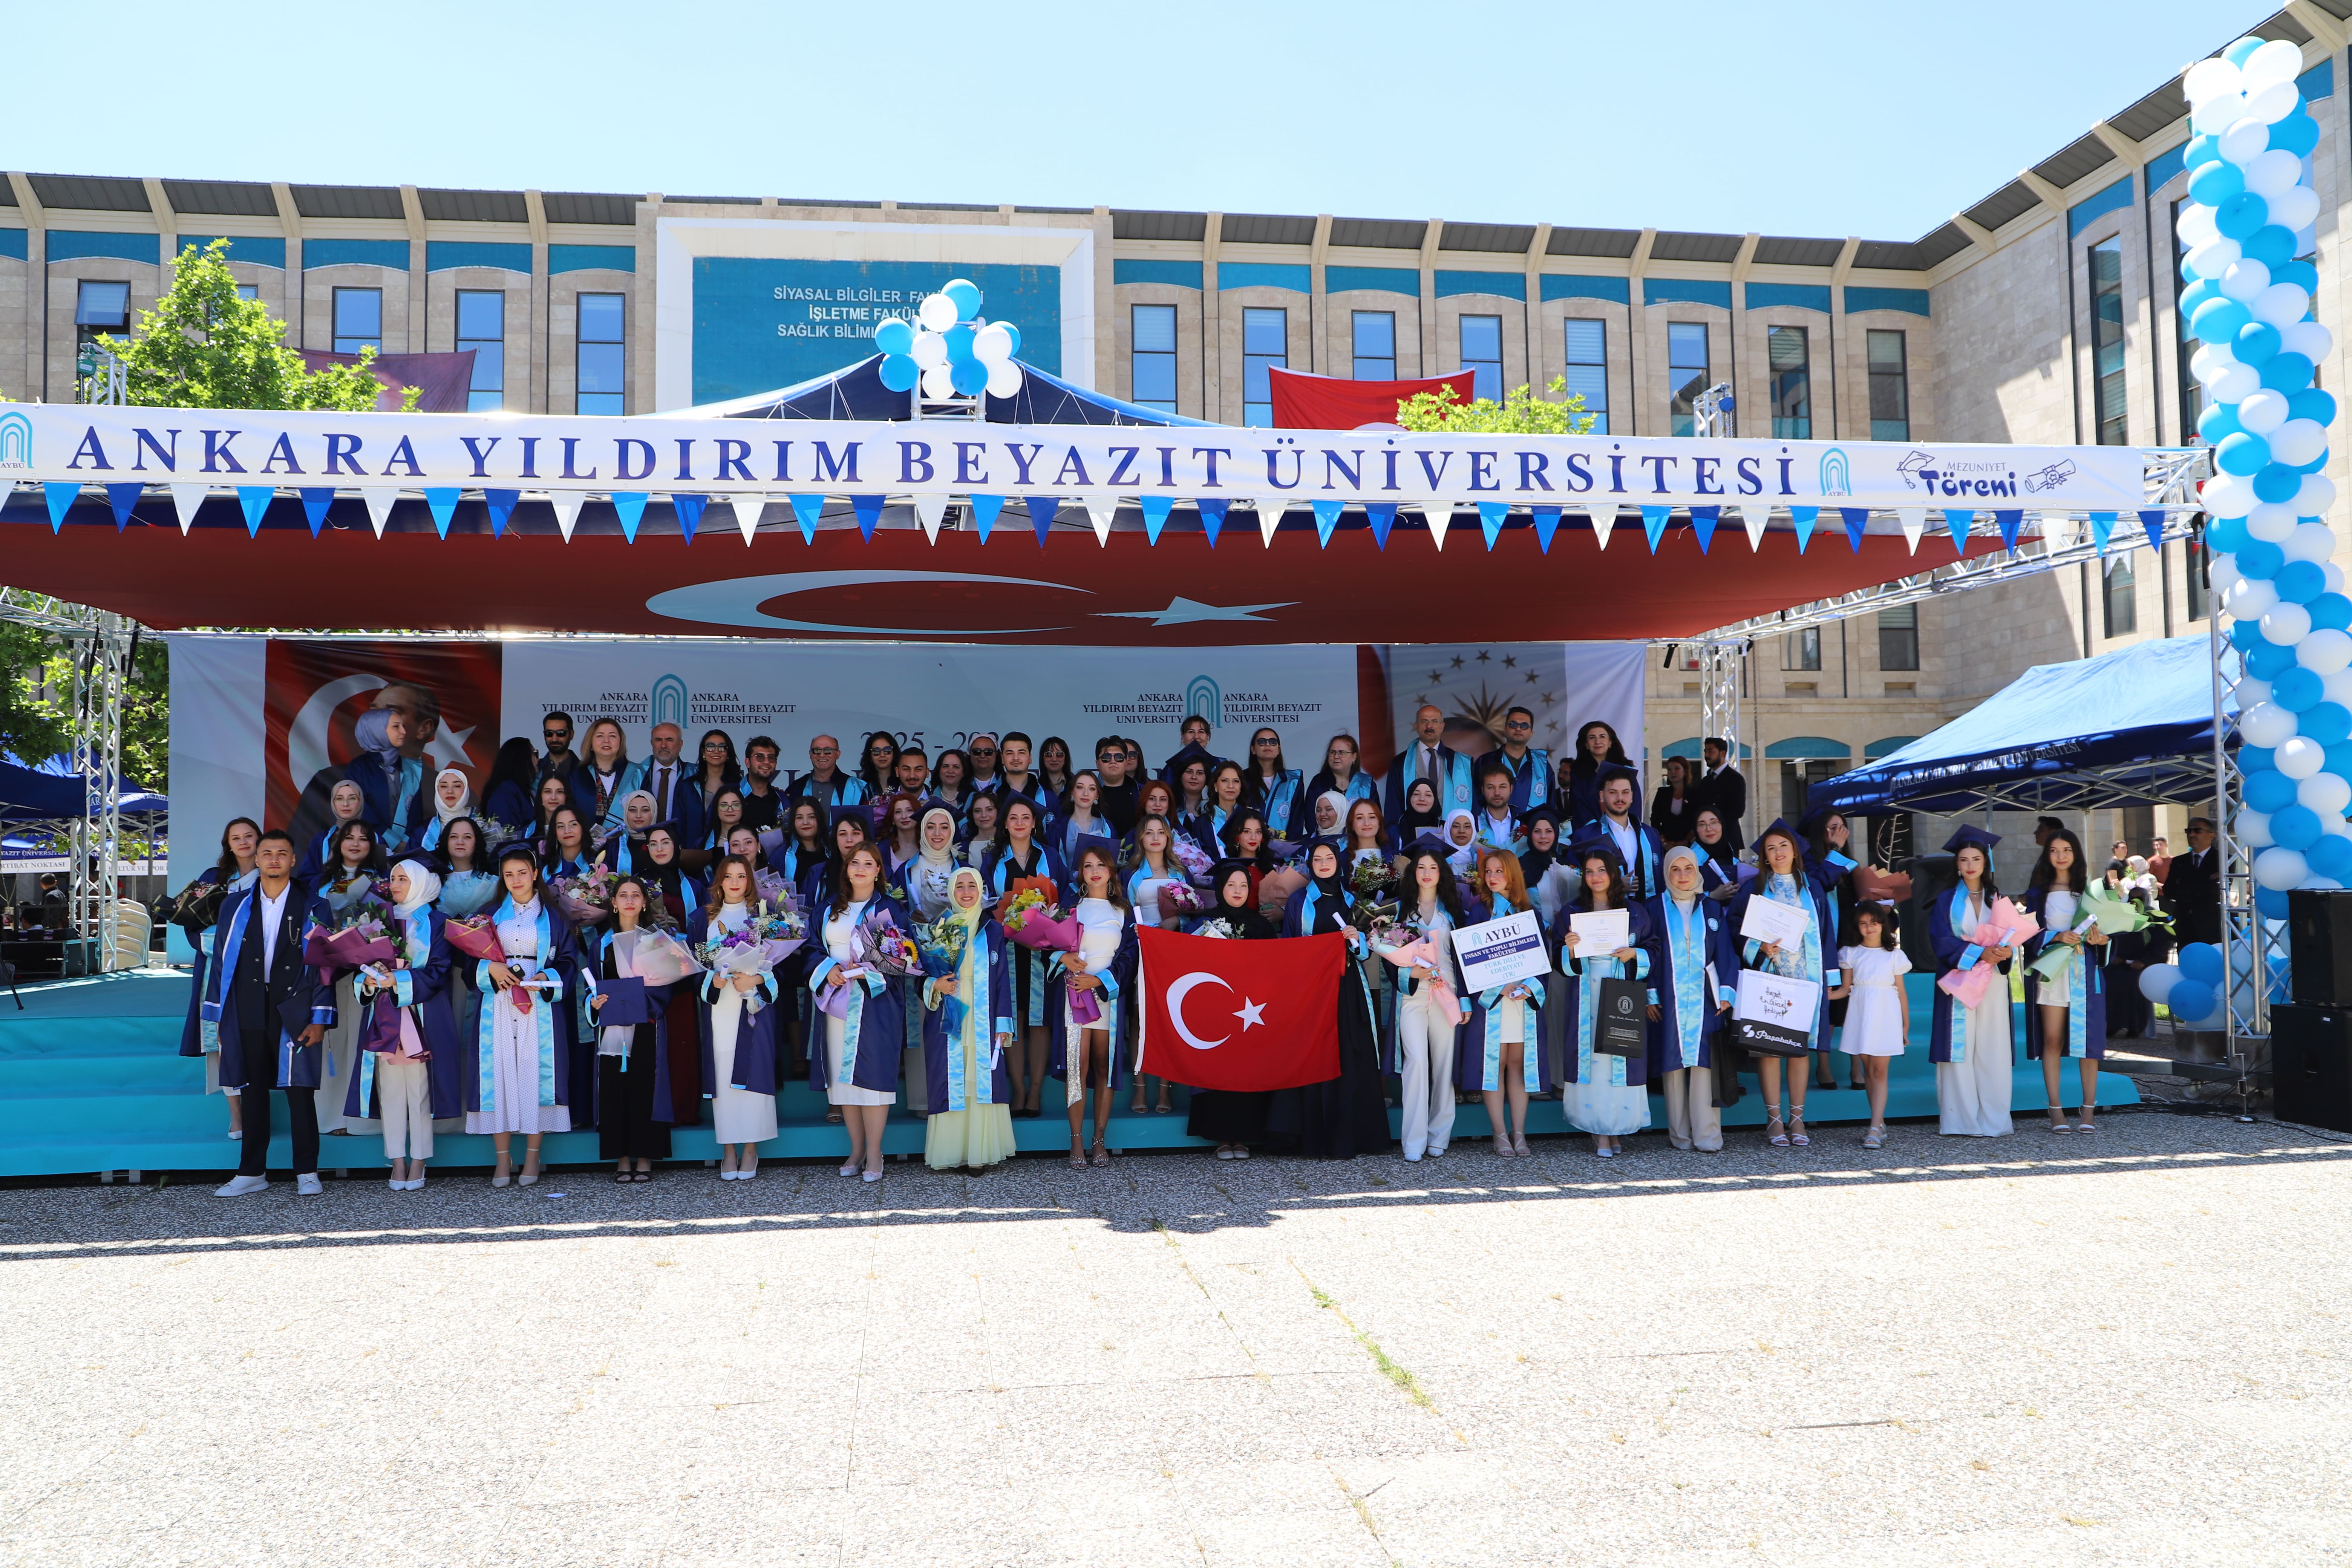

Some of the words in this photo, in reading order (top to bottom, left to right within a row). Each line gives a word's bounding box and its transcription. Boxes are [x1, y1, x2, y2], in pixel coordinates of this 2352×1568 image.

[774, 285, 833, 301] SİYASAL
[837, 287, 901, 302] BİLGİLER
[809, 304, 870, 322] İŞLETME
[778, 322, 829, 337] SAĞLIK
[66, 426, 427, 476] ANKARA
[459, 437, 863, 482] YILDIRIM
[896, 441, 1231, 487] BEYAZIT
[1262, 438, 1795, 496] ÜNİVERSİTESİ
[1947, 461, 2007, 472] MEZUNİYET
[1919, 470, 2017, 498] Töreni
[691, 713, 772, 723] ÜNİVERSİTESİ
[1224, 712, 1299, 723] ÜNİVERSİTESİ
[1896, 771, 1929, 789] ANKARA
[1929, 763, 1970, 781] YILDIRIM
[1971, 755, 2009, 772] BEYAZIT
[1485, 923, 1521, 942] AYBÜ
[1464, 950, 1482, 960] İNSAN
[1490, 944, 1508, 952] TOPLU
[1509, 936, 1536, 947] BİLİMLERİ
[1488, 947, 1516, 959] FAKÜLTESİ
[1484, 959, 1502, 969] TÜRK
[1491, 962, 1524, 974] EDEBİYATI
[1503, 971, 1515, 979] (TR)
[1766, 987, 1782, 999] Hayat
[1759, 996, 1769, 1004] En
[1769, 999, 1786, 1009] Güzel
[1755, 1030, 1802, 1047] Paşabahçe
